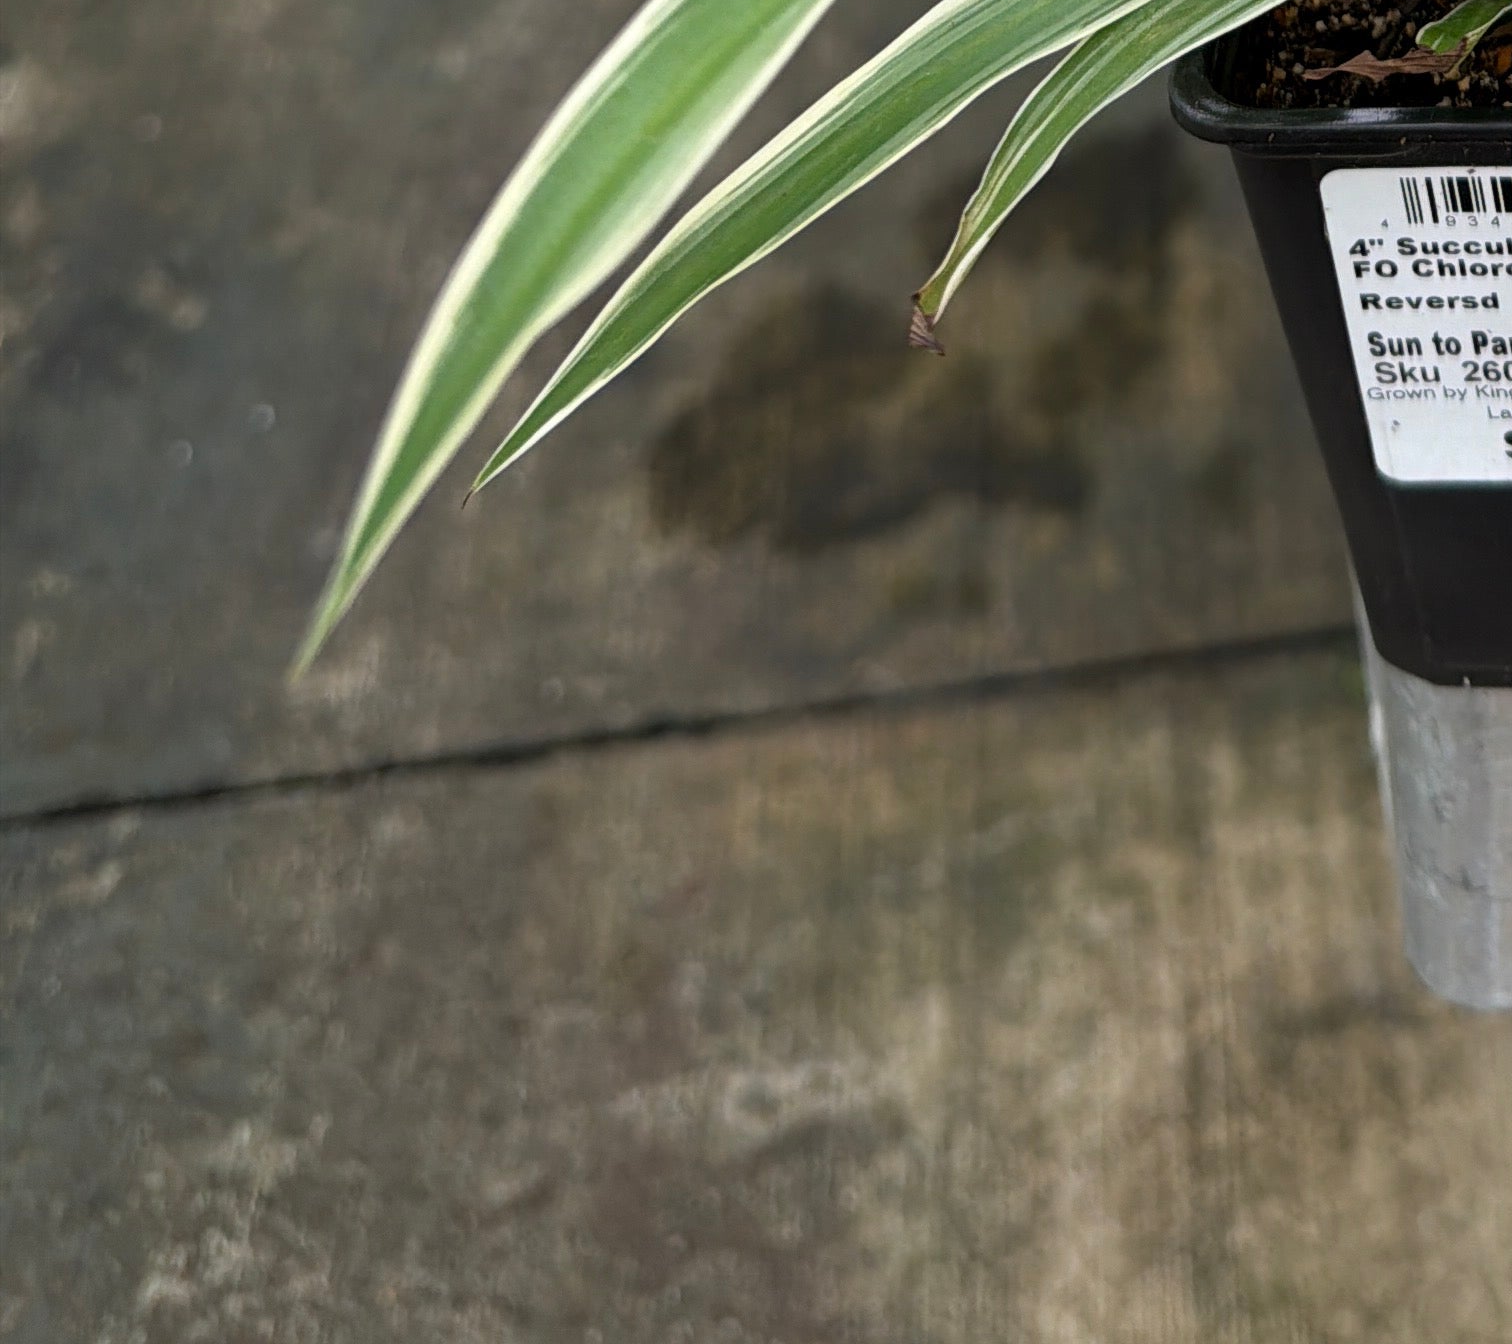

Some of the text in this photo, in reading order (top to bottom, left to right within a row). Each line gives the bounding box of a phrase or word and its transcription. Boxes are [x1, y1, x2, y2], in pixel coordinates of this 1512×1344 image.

[1349, 238, 1384, 256] 4"
[1353, 260, 1398, 278] FO
[1360, 292, 1499, 310] Reversd
[1367, 330, 1422, 357] Sun
[1432, 330, 1462, 356] to
[1374, 361, 1441, 384] Sku
[1367, 386, 1436, 400] Grown
[1443, 385, 1468, 401] by
[1487, 405, 1512, 419] La
